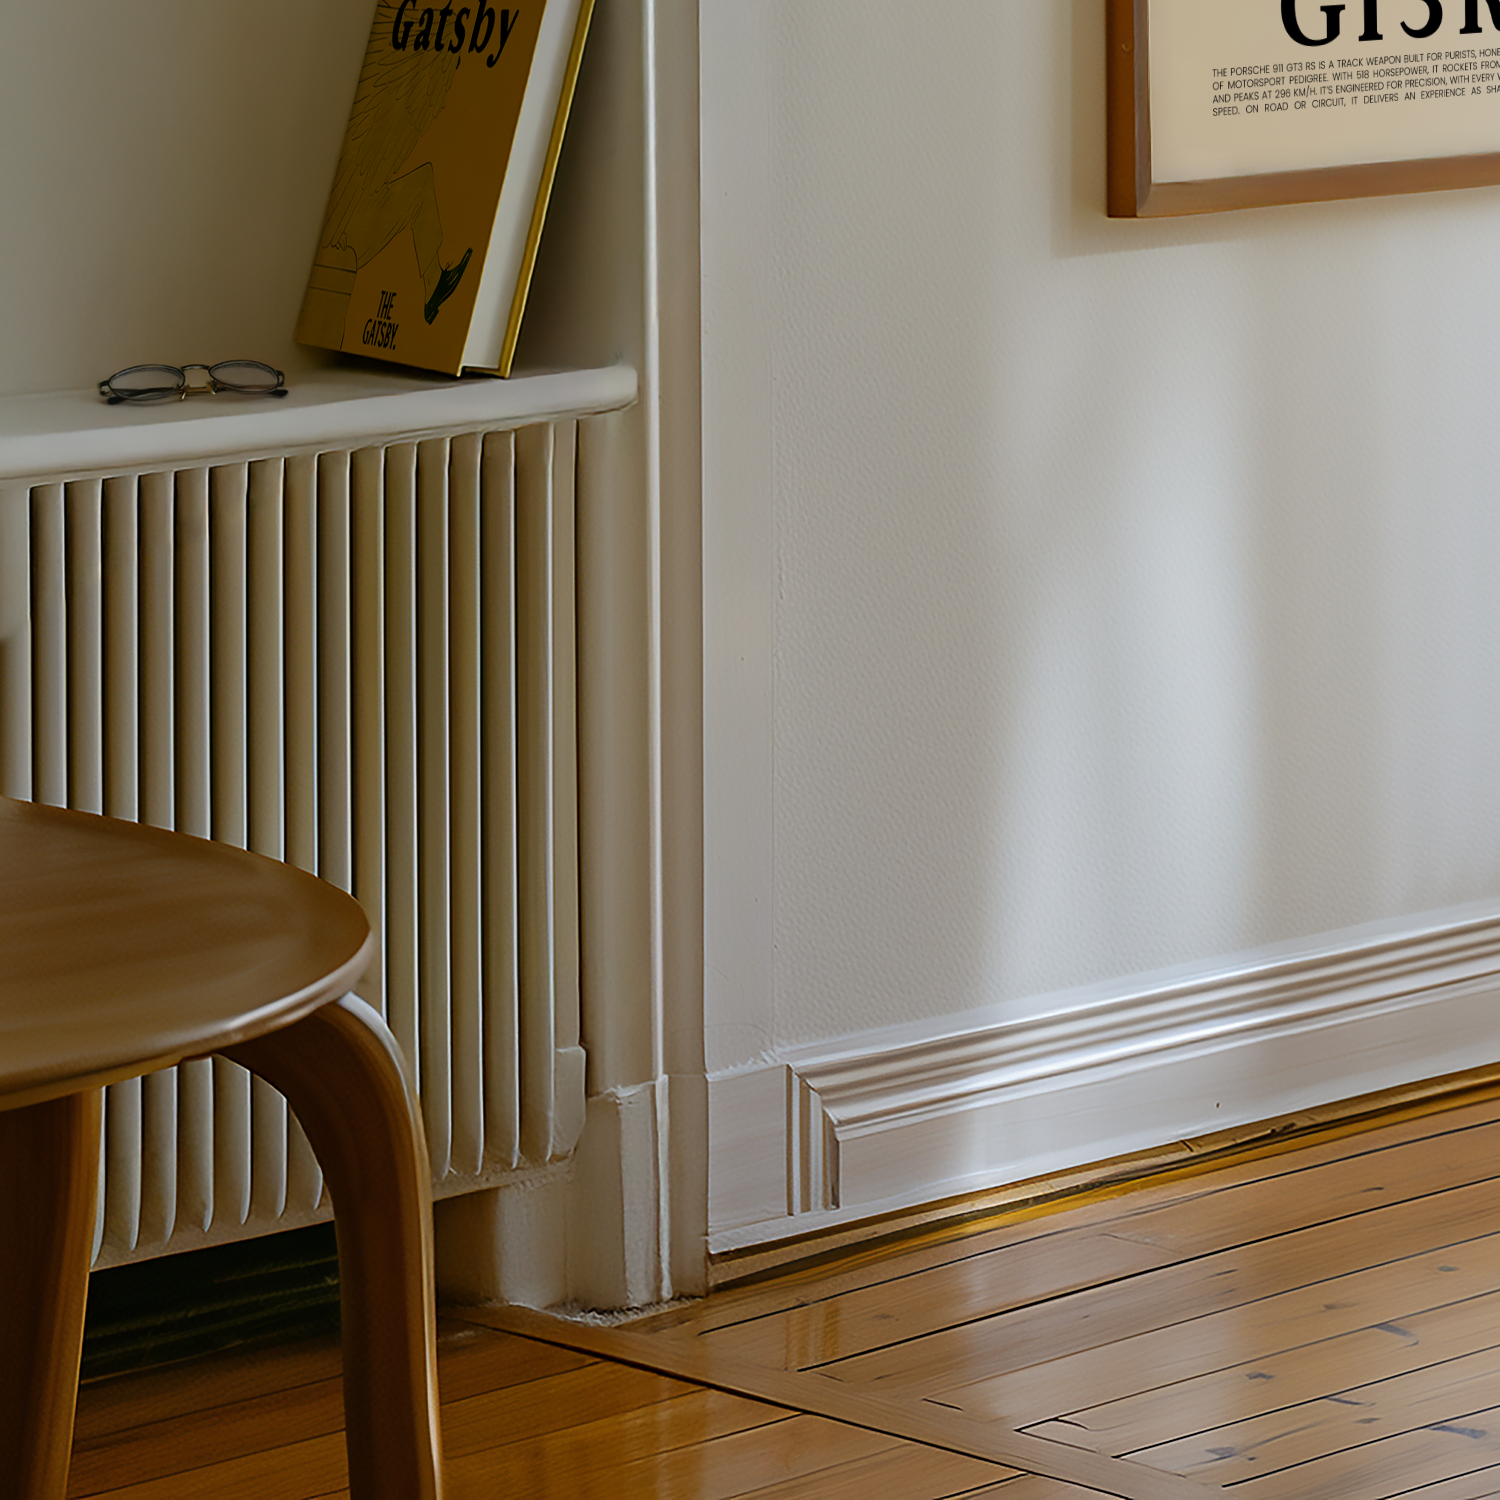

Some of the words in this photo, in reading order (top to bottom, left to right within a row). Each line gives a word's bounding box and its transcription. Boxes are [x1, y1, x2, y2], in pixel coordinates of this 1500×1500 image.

[1212, 67, 1227, 78] THE
[1230, 64, 1270, 76] PORSCHE
[1273, 63, 1283, 73] 911
[1286, 62, 1303, 72] GT3
[1306, 61, 1316, 71] RS
[1318, 60, 1325, 70] IS
[1328, 60, 1334, 69] A
[1337, 57, 1363, 68] TRACK
[1366, 55, 1401, 66] WEAPON
[1404, 53, 1424, 63] BUILT
[1426, 52, 1442, 62] FOR
[1445, 49, 1477, 60] PURISTS,
[1212, 81, 1224, 91] OF
[1228, 76, 1285, 89] MOTORSPORT
[1332, 71, 1353, 81] WITH
[1356, 70, 1369, 80] 518
[1373, 65, 1429, 78] HORSEPOWER,
[1432, 64, 1438, 74] IT
[1442, 61, 1478, 73] ROCKETS
[1212, 93, 1231, 104] AND
[1234, 91, 1259, 102] PEAKS
[1262, 90, 1272, 100] AT
[1275, 88, 1291, 99] 296
[1294, 85, 1317, 98] KM/H.
[1336, 81, 1384, 94] ENGINEERED
[1386, 80, 1402, 90] FOR
[1405, 76, 1447, 88] PRECISION,
[1450, 74, 1469, 85] WITH
[1472, 72, 1495, 83] EVERY
[1212, 105, 1240, 117] SPEED.
[1246, 104, 1258, 114] ON
[1264, 102, 1288, 112] ROAD
[1294, 100, 1306, 110] OR
[1312, 97, 1346, 109] CIRCUIT,
[1351, 96, 1358, 105] IT
[1364, 93, 1399, 104] DELIVERS
[1404, 91, 1415, 101] AN
[1421, 87, 1465, 100] EXPERIENCE
[1471, 86, 1481, 96] AS
[376, 290, 396, 320] THE
[362, 318, 398, 351] GATSBY.
